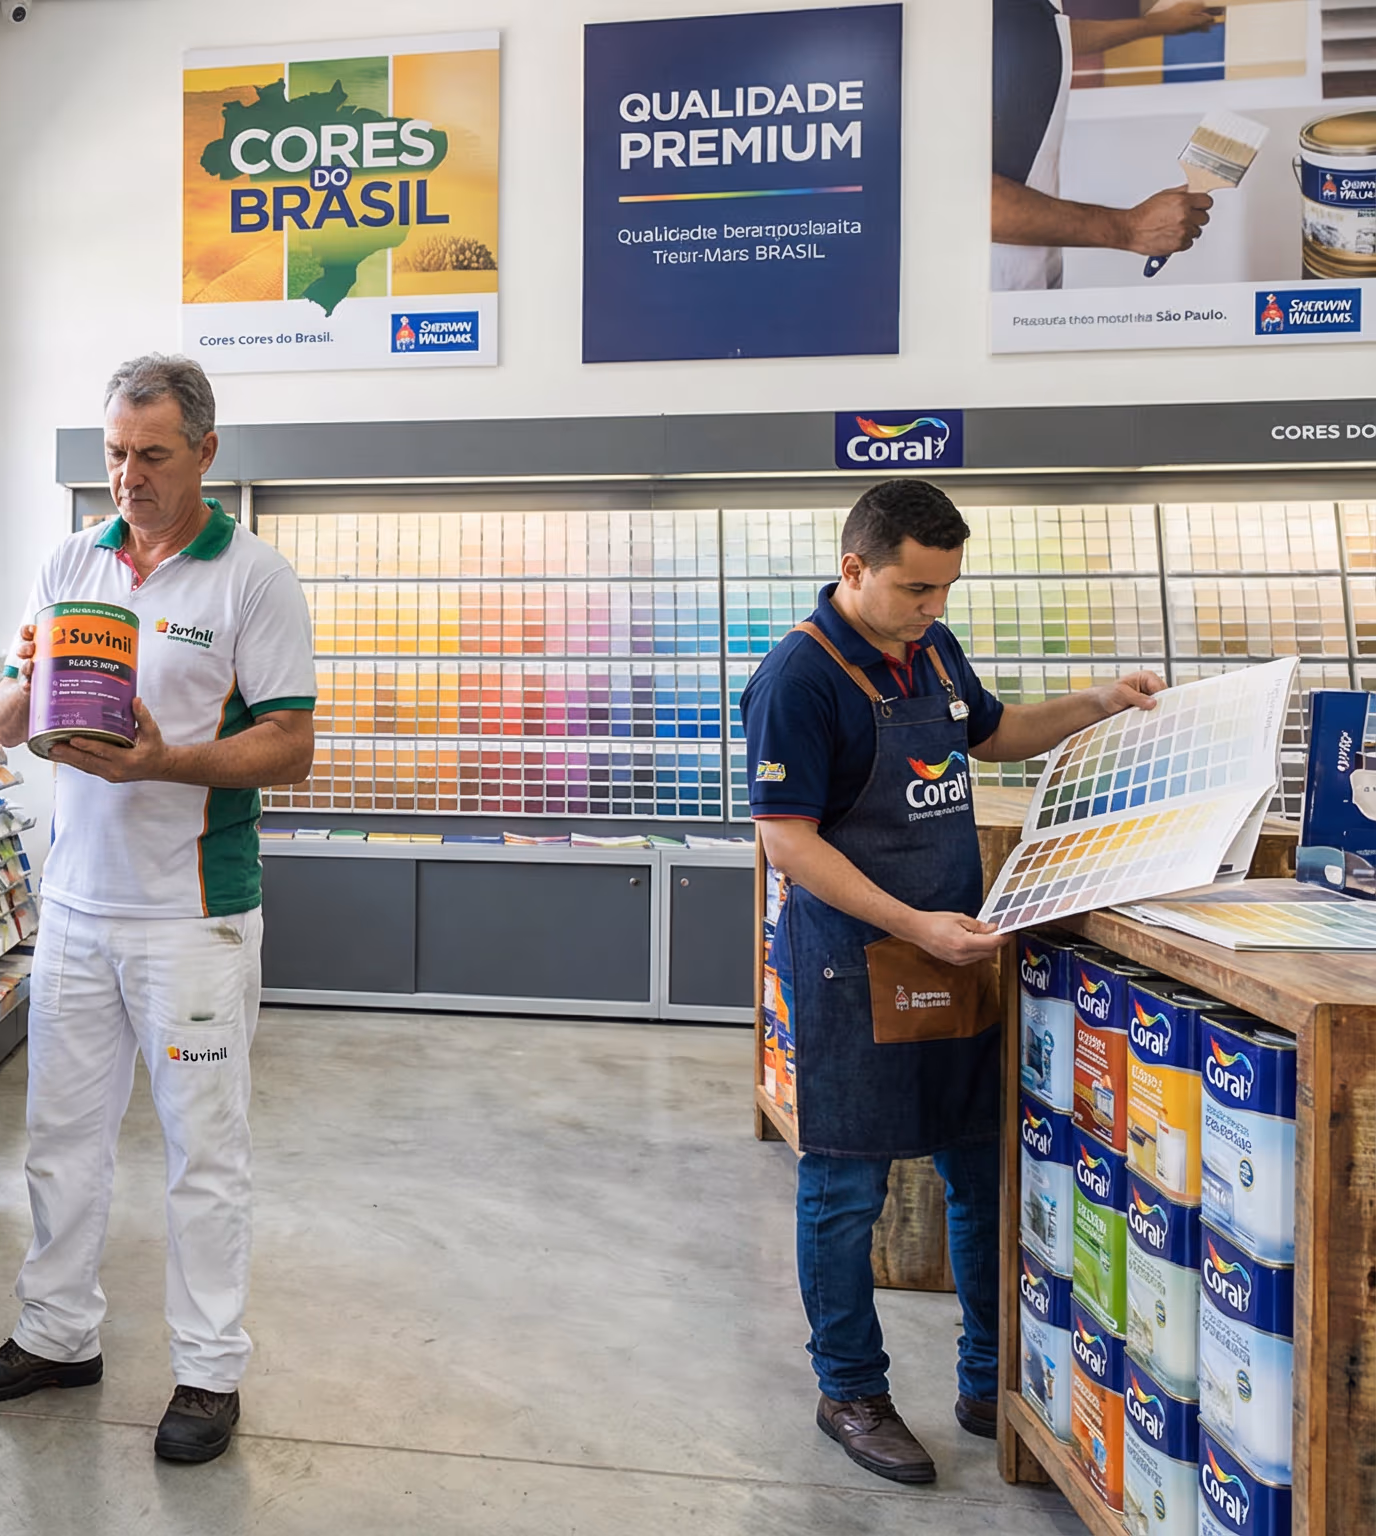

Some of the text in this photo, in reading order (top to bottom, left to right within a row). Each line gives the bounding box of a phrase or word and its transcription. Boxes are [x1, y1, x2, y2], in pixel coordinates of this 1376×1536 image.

[618, 80, 863, 122] QUALIDADE
[230, 119, 435, 175] CORES
[619, 120, 862, 170] PREMIUM
[313, 167, 348, 187] DO
[230, 179, 450, 233] BRASIL
[755, 243, 826, 260] BRASIL
[1156, 309, 1182, 322] São
[1184, 309, 1227, 321] Paulo.
[199, 335, 236, 346] Cores
[276, 333, 292, 344] do
[295, 331, 334, 343] Brasil.
[846, 435, 933, 462] Coral
[1271, 423, 1376, 440] CORES DO
[69, 628, 132, 654] Suvinil
[905, 773, 966, 809] Coral
[1077, 986, 1105, 1019] Coral
[182, 1047, 228, 1062] Suvinil
[1130, 1017, 1164, 1057] Coral
[1206, 1055, 1245, 1101] Coral
[1022, 1119, 1048, 1155] Coral
[1077, 1159, 1106, 1198] Coral
[1128, 1203, 1161, 1249] Coral
[1021, 1274, 1045, 1314] Coral
[1202, 1258, 1245, 1312] Coral
[1073, 1330, 1103, 1377] Coral
[1126, 1385, 1160, 1441] Coral
[1202, 1463, 1241, 1526] Coral
